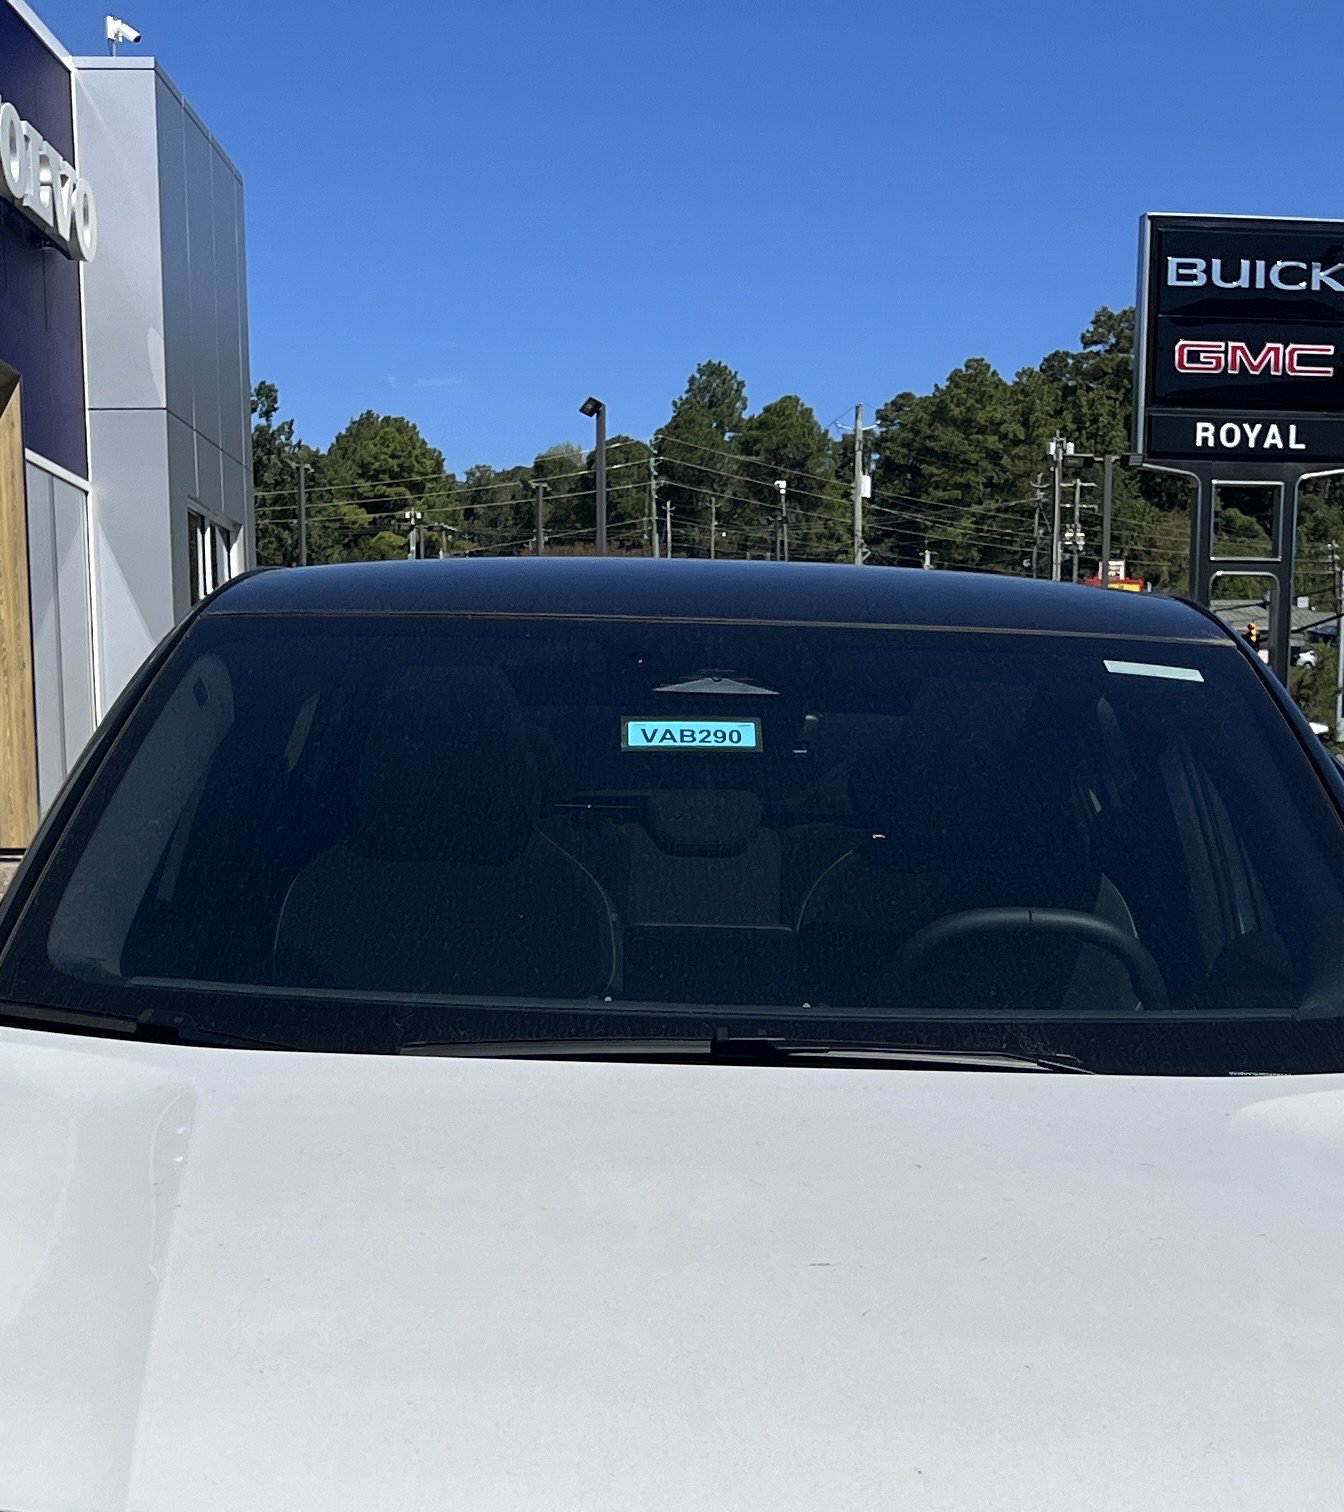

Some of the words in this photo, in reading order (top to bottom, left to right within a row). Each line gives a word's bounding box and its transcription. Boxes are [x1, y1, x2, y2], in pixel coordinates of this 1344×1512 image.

[1174, 340, 1335, 376] GMC
[1195, 422, 1306, 450] ROYAL
[640, 728, 742, 744] VAB290
